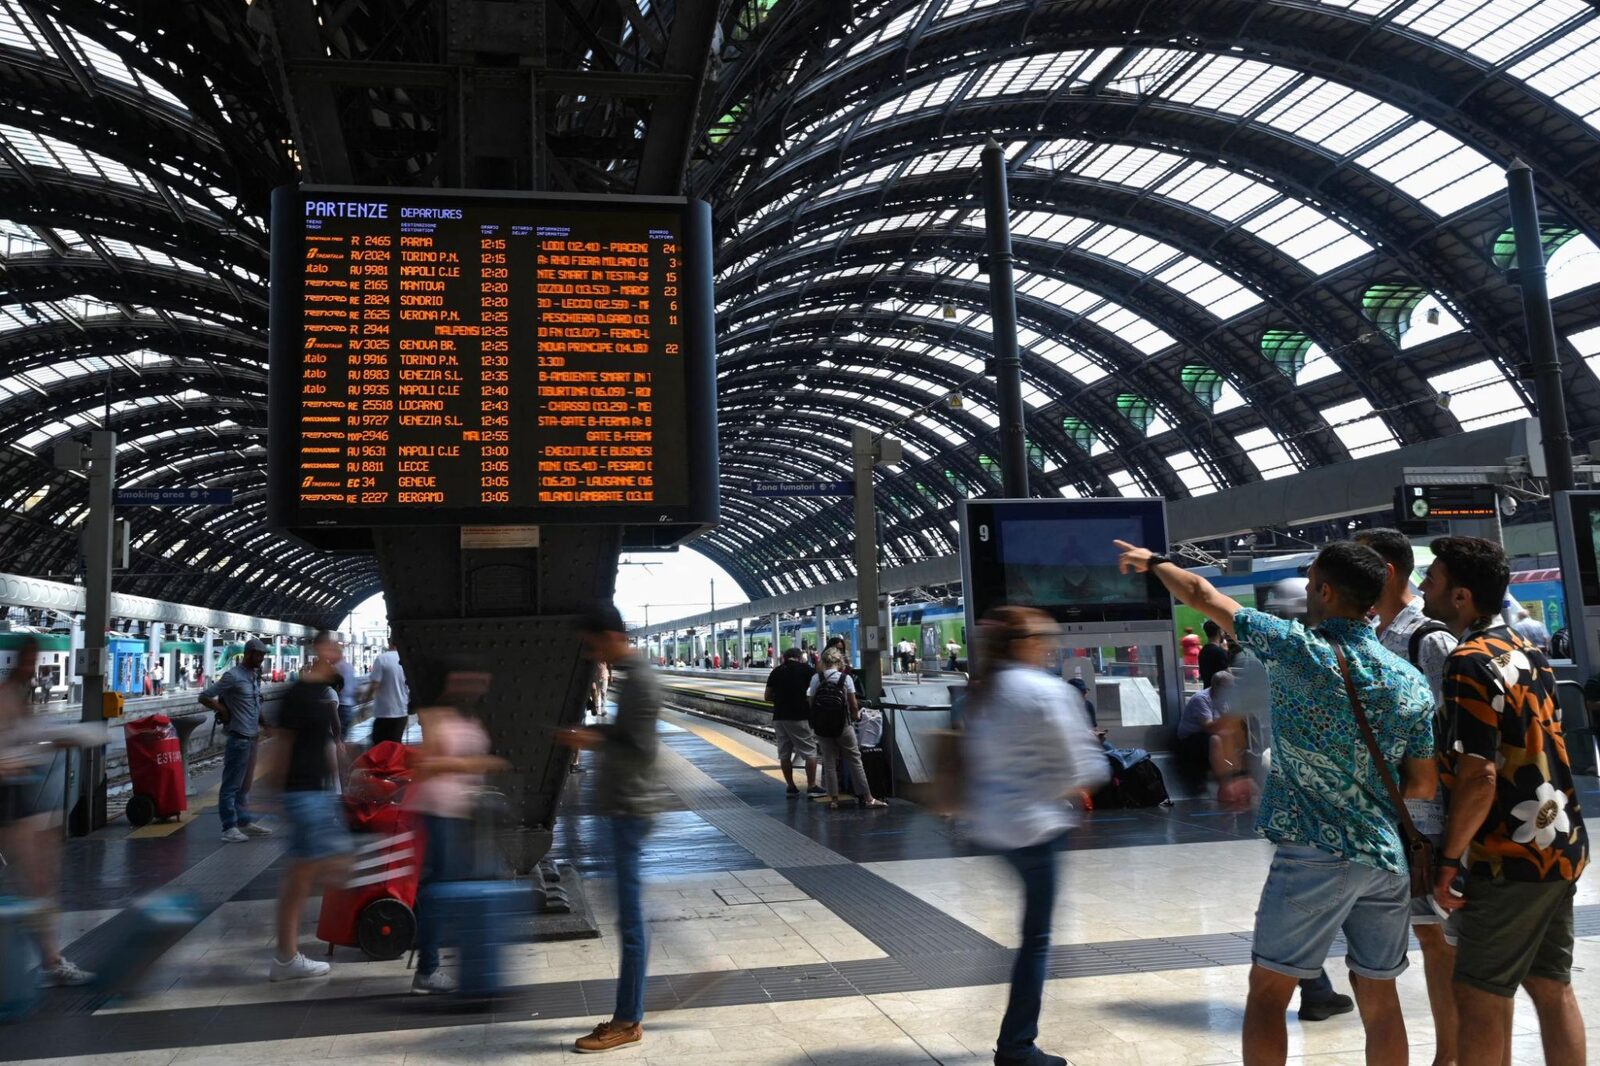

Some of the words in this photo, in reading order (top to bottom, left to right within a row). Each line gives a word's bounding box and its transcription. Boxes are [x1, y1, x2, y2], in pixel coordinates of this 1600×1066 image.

[306, 201, 388, 218] PARTENZE
[401, 208, 462, 219] DEPARTURES
[351, 236, 360, 245] R
[365, 236, 391, 246] 2465
[401, 237, 432, 246] PARMA
[481, 239, 505, 249] 12:15
[663, 244, 676, 253] 24
[363, 250, 391, 260] 2024
[401, 251, 437, 262] TORINO
[440, 252, 459, 262] P.N.
[481, 254, 505, 263] 12:15
[670, 258, 676, 268] 3
[364, 265, 388, 275] 9981
[400, 266, 435, 276] NAPOLI
[439, 267, 459, 277] C.LE
[481, 268, 508, 278] 12:20
[666, 272, 677, 282] 15
[350, 282, 360, 290] RE
[364, 280, 388, 290] 2165
[400, 281, 445, 291] MANTOVA
[481, 282, 508, 292] 12:20
[664, 287, 677, 296] 23
[349, 296, 360, 304] RE
[364, 295, 390, 304] 2824
[400, 295, 443, 306] SONDRIO
[481, 297, 508, 307] 12:20
[670, 301, 677, 310] 6
[349, 311, 359, 319] RE
[364, 309, 390, 319] 2625
[400, 310, 438, 320] VERONA
[440, 311, 460, 320] P.N.
[481, 312, 508, 321] 12:25
[669, 316, 677, 324] 11
[349, 325, 358, 334] R
[364, 324, 389, 334] 2944
[481, 326, 508, 336] 12:25
[363, 339, 390, 349] 3025
[400, 340, 438, 350] GENOVA
[440, 340, 456, 350] BR.
[481, 341, 508, 351] 12:25
[666, 344, 678, 353] 22
[363, 354, 387, 364] 9916
[400, 355, 436, 365] TORINO
[439, 355, 458, 365] P.N.
[481, 356, 508, 366] 12:30
[363, 370, 389, 380] 8983
[400, 370, 442, 380] VENEZIA
[444, 371, 463, 380] S.L.
[481, 371, 508, 381] 12:35
[363, 385, 389, 395] 9935
[399, 385, 434, 395] NAPOLI
[438, 385, 459, 395] C.LE
[481, 386, 508, 396] 12:40
[348, 402, 358, 410] RE
[363, 400, 393, 410] 25518
[399, 400, 443, 410] LOCARNO
[481, 401, 508, 411] 12:43
[363, 415, 389, 425] 9727
[399, 415, 442, 425] VENEZIA
[444, 416, 463, 426] S.L.
[481, 416, 508, 426] 12:45
[362, 431, 389, 441] 2946
[481, 431, 508, 441] 12:55
[362, 446, 386, 456] 9631
[399, 446, 434, 456] NAPOLI
[438, 446, 459, 456] C.LE
[481, 446, 508, 456] 13:00
[362, 461, 383, 471] 8811
[399, 461, 429, 471] LECCE
[481, 461, 508, 471] 13:05
[347, 479, 360, 488] EC
[362, 477, 375, 487] 34
[399, 477, 436, 487] GENEVE
[481, 477, 509, 486] 13:05
[118, 490, 159, 500] Smoking
[347, 495, 357, 503] RE
[362, 492, 388, 502] 2227
[398, 492, 443, 502] BERGAMO
[481, 492, 509, 502] 13:05
[979, 524, 989, 542] 9
